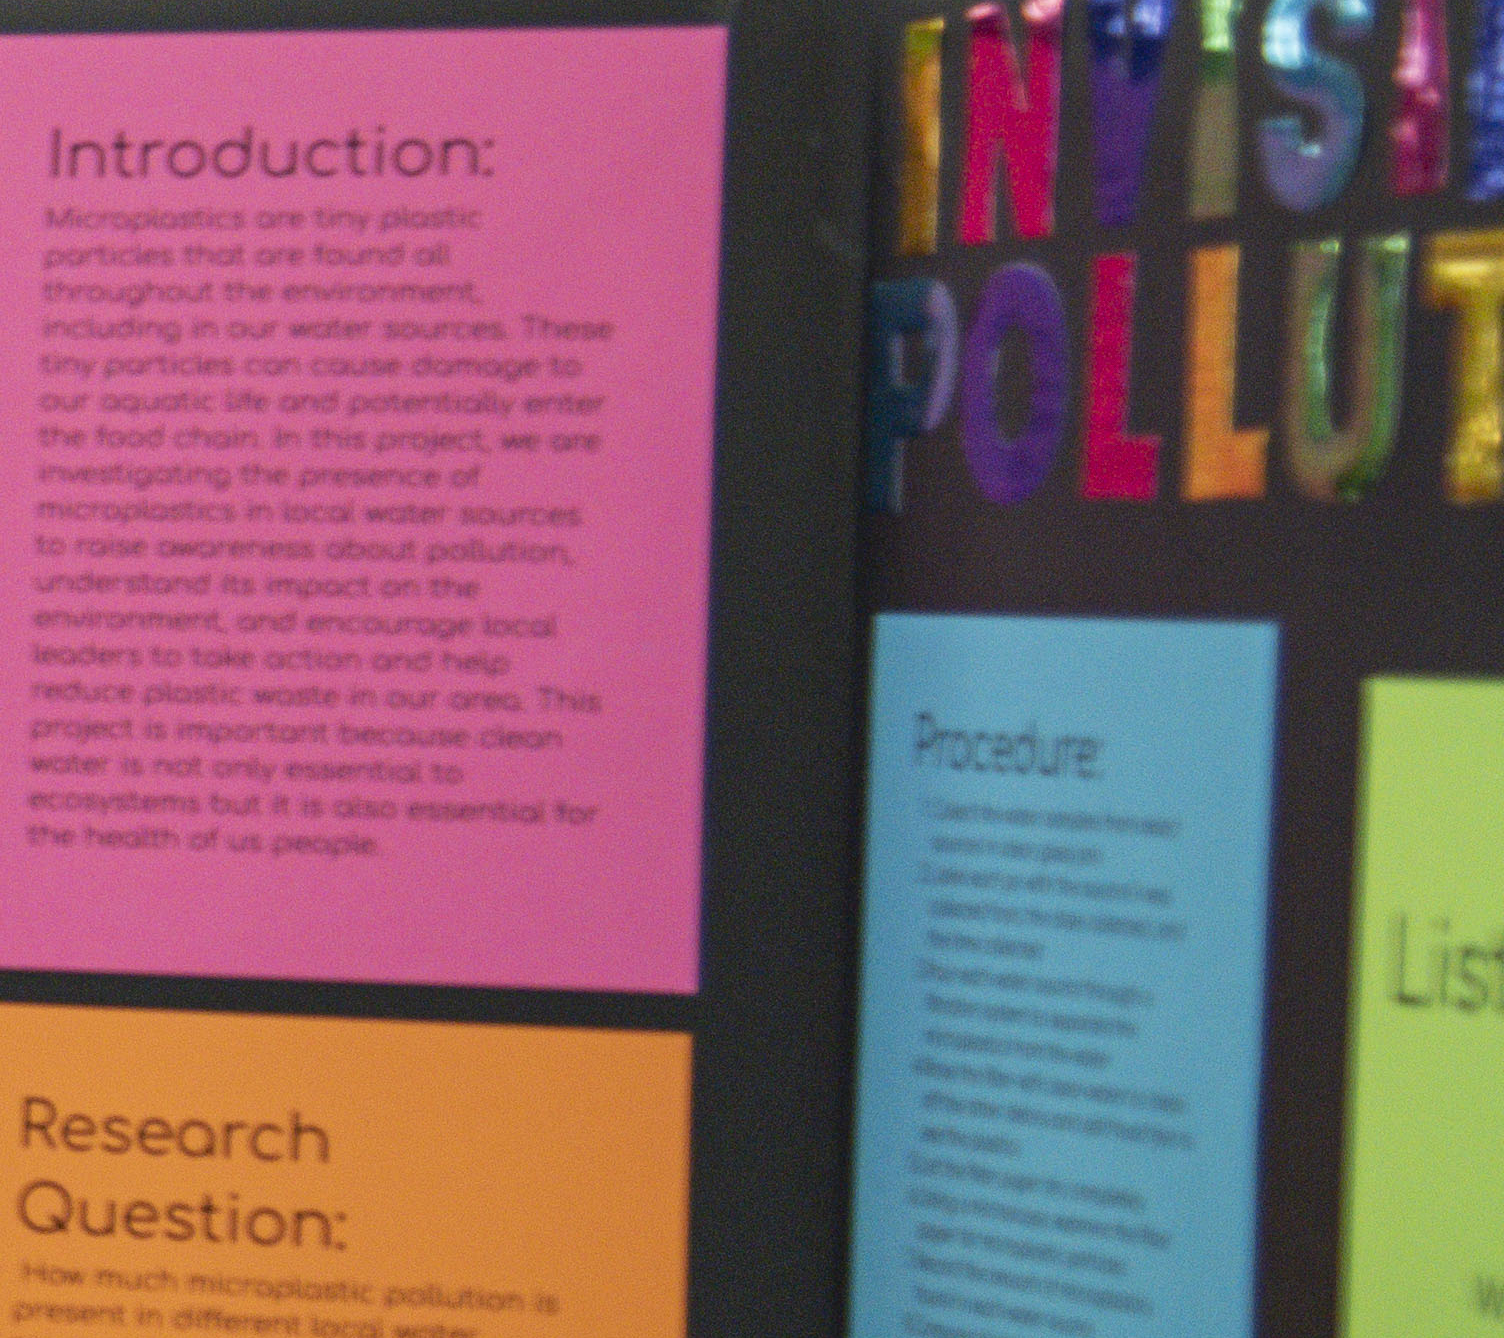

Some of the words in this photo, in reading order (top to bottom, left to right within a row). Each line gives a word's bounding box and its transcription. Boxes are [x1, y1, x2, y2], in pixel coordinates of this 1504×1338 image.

[49, 125, 495, 181] Introduction:
[42, 206, 246, 234] Microplastics
[256, 211, 306, 230] are
[313, 208, 371, 232] tiny
[378, 207, 481, 233] plastic
[41, 245, 173, 272] particles
[183, 245, 245, 267] that
[254, 247, 305, 266] are
[312, 243, 406, 266] found
[414, 242, 451, 266] all
[913, 710, 1106, 782] Procedure:
[19, 1095, 331, 1164] Research
[15, 1177, 347, 1252] Question:
[20, 1261, 85, 1286] How
[94, 1269, 177, 1291] much
[187, 1274, 372, 1305] microplastic
[381, 1282, 526, 1313] pollution
